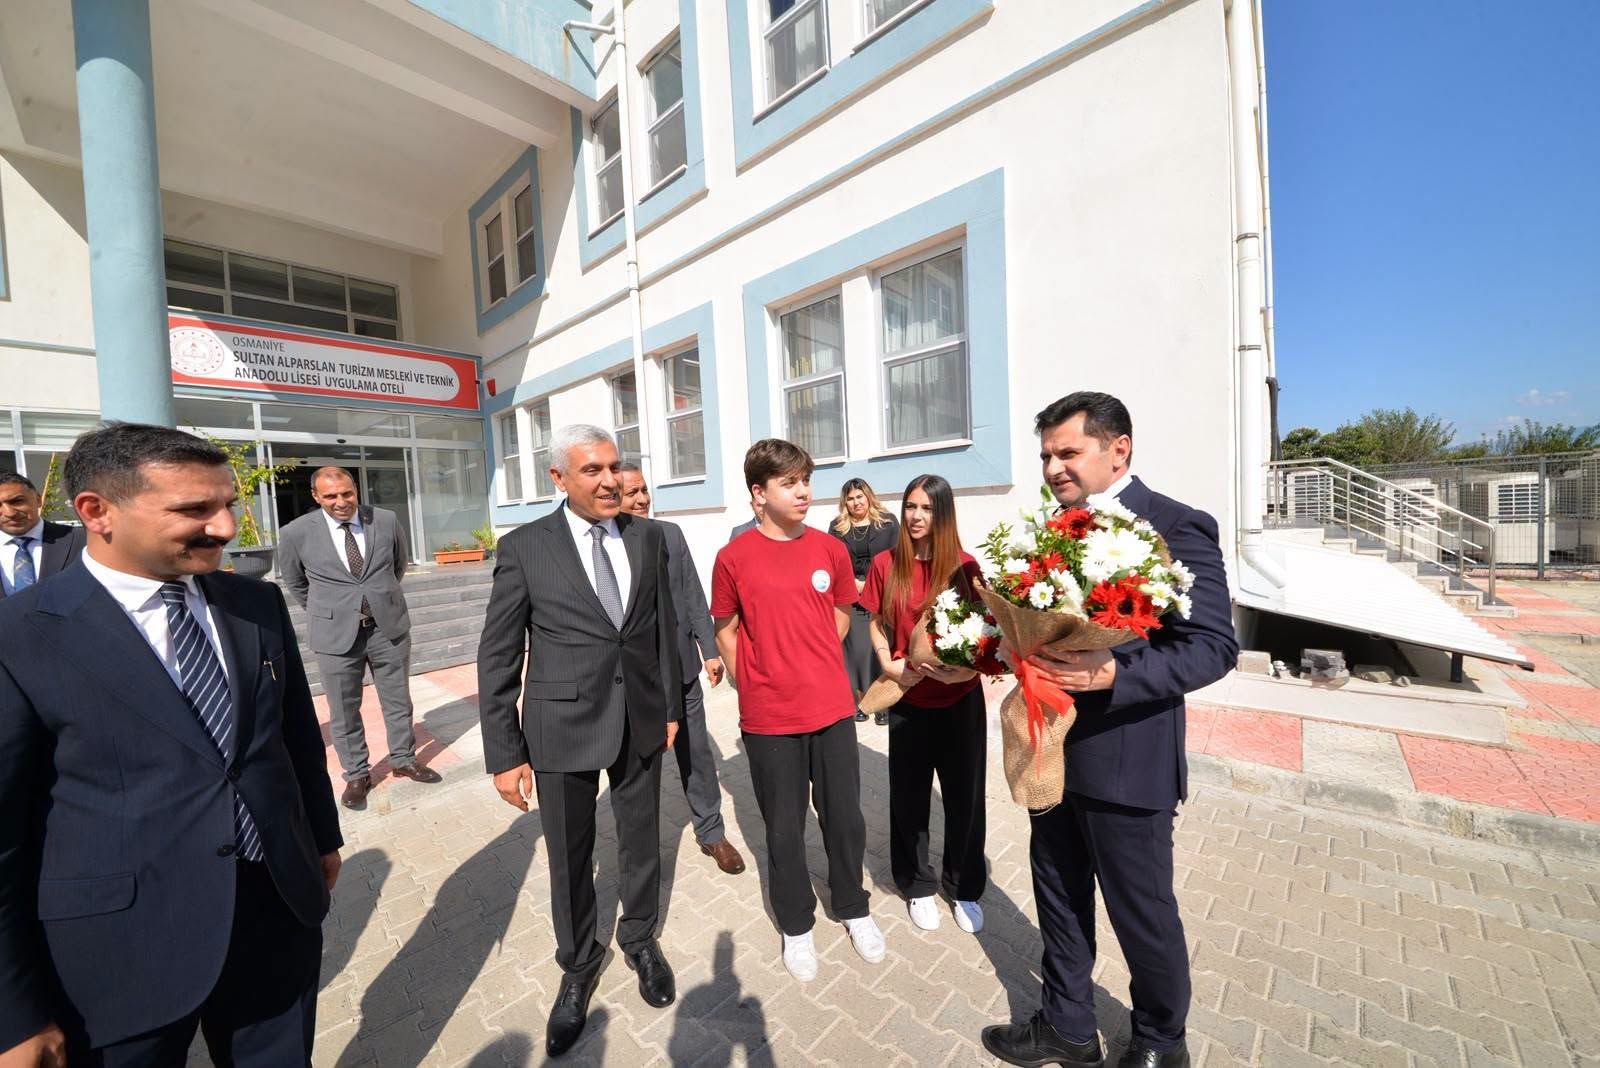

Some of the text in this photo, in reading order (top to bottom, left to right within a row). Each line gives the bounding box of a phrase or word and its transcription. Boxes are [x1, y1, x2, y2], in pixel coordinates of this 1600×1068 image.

[232, 336, 286, 352] OSMANİYE
[233, 350, 455, 387] SULTAN ALPARSLAN TURİZM MESLEKİ VE TEKNİK
[234, 367, 405, 395] ANADOLU LİSESİ UYGULAMA OTELİ
